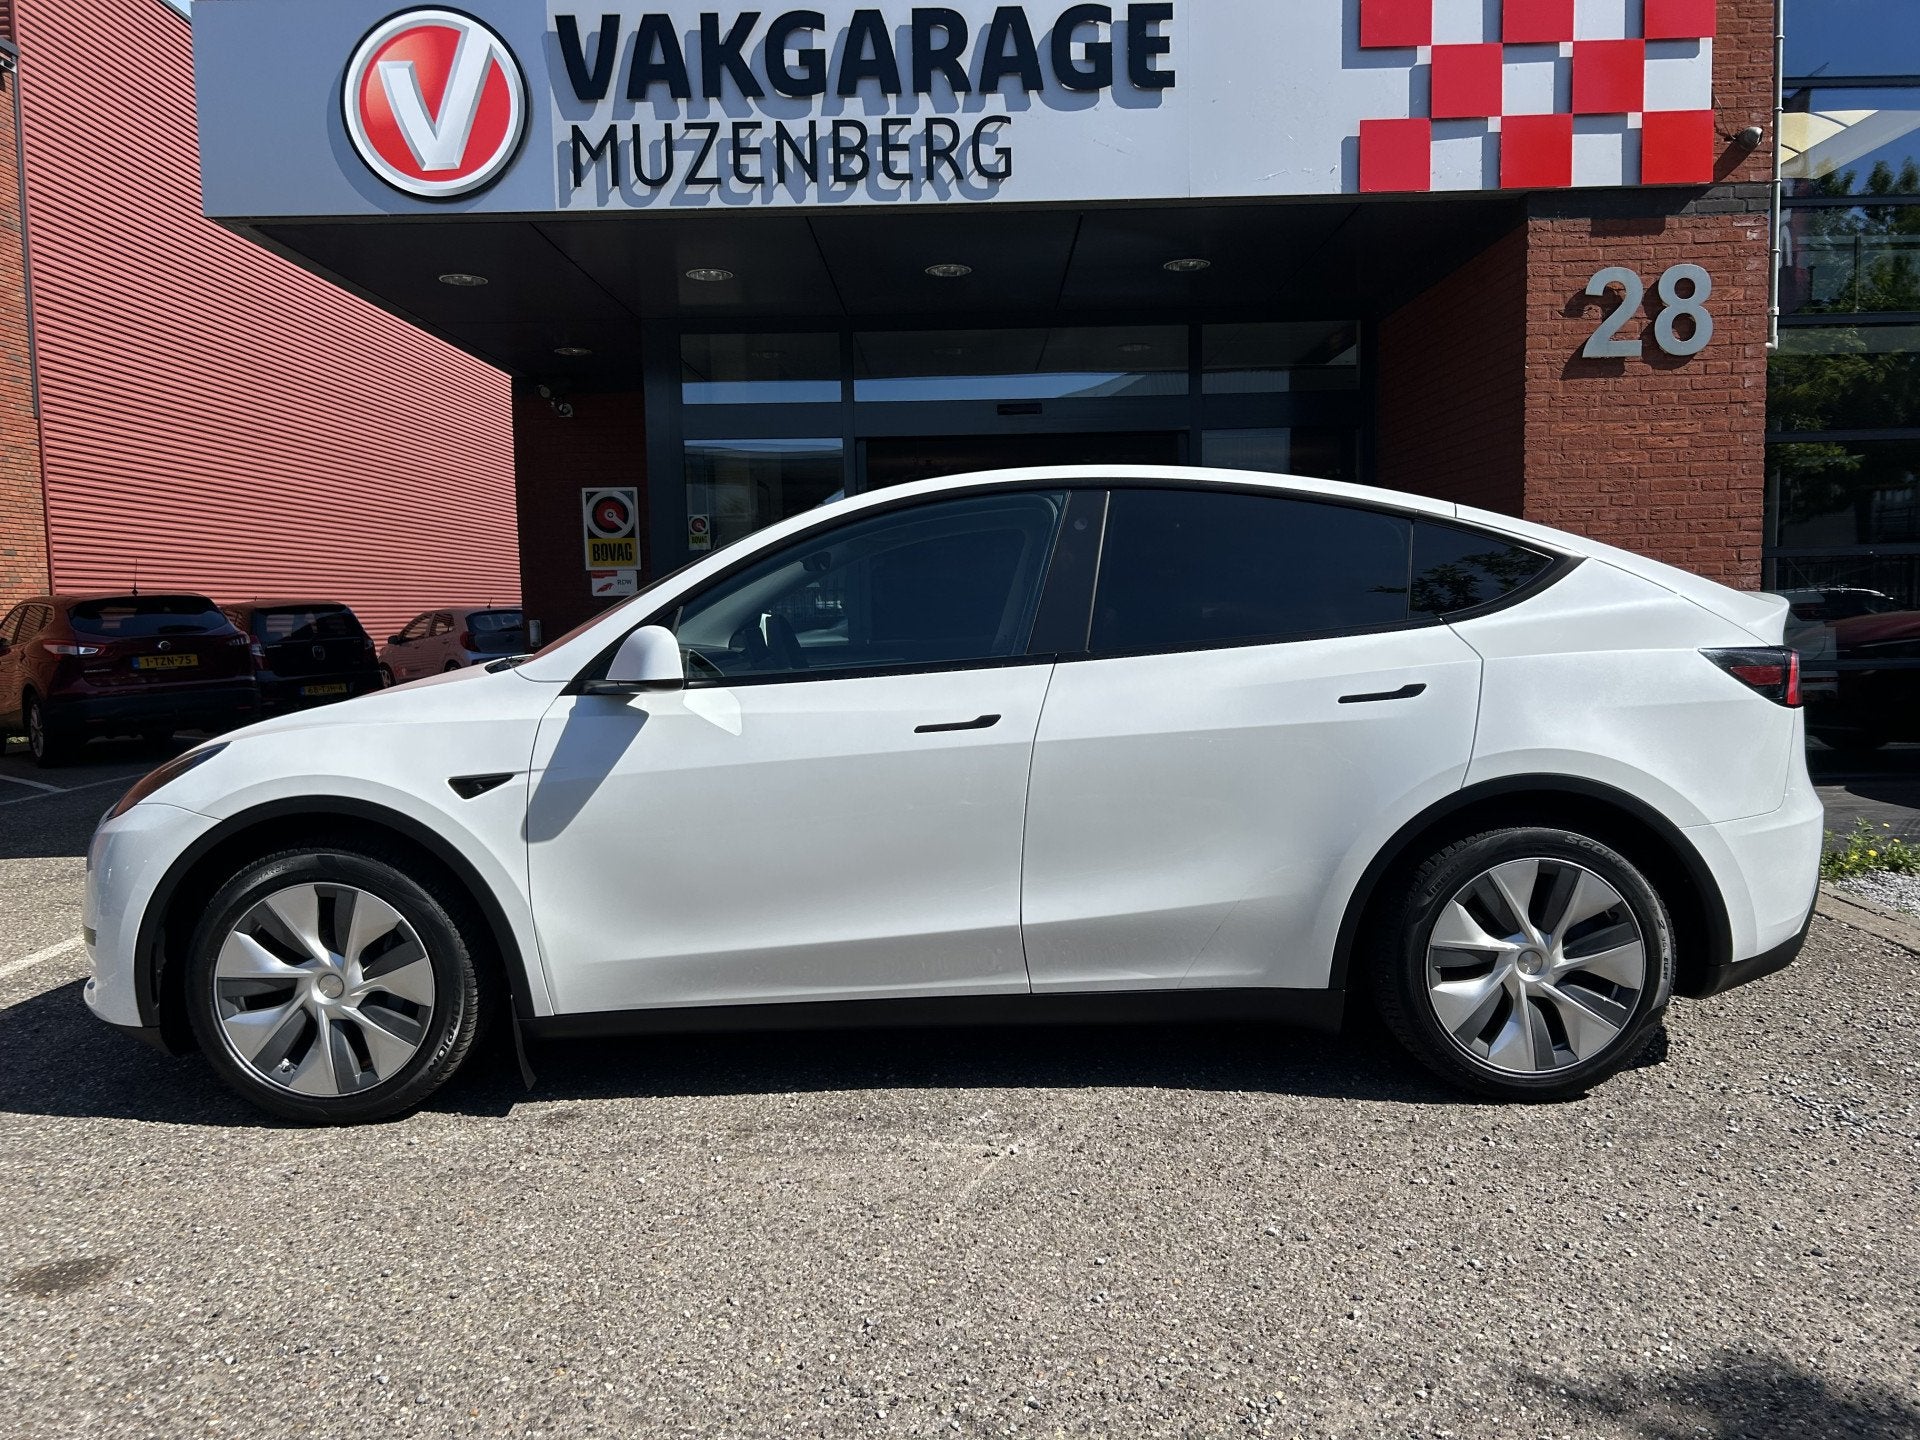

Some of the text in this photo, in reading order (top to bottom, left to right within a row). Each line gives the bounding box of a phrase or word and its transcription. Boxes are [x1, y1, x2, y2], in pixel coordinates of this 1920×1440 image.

[555, 3, 1176, 101] VAKGARAGE
[377, 24, 494, 172] V
[572, 116, 1012, 187] MUZENBERG
[1582, 264, 1713, 358] 28
[592, 542, 633, 562] BOVAG
[144, 655, 192, 668] 1-TZN-75
